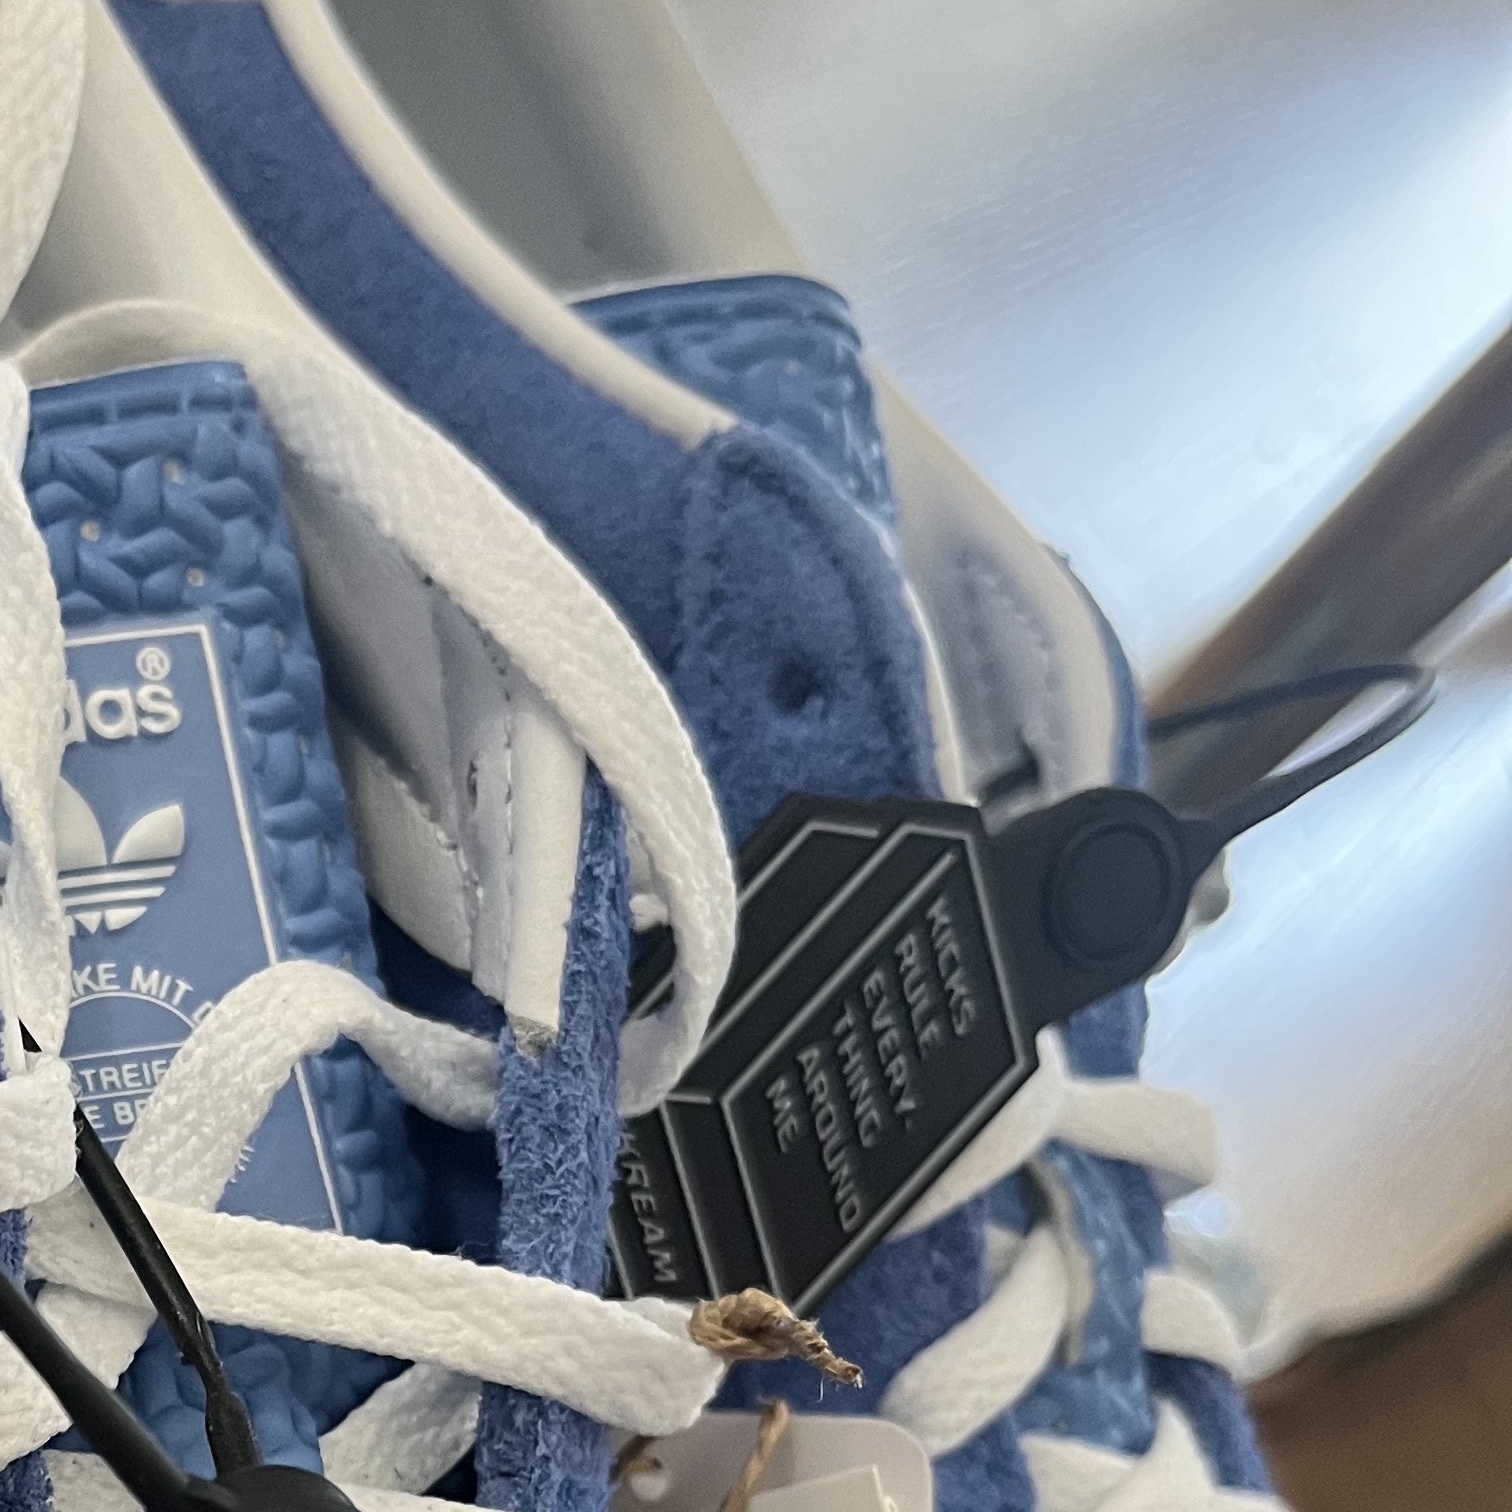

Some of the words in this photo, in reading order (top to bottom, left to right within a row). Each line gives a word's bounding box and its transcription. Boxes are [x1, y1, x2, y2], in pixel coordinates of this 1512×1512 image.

[131, 965, 194, 1006] MIT
[895, 932, 941, 1060] RULE
[926, 898, 976, 1037] KICKS
[765, 1075, 801, 1154] ME
[796, 1046, 862, 1233] AROUND
[832, 1001, 882, 1148] THING
[618, 1132, 677, 1283] KREAM
